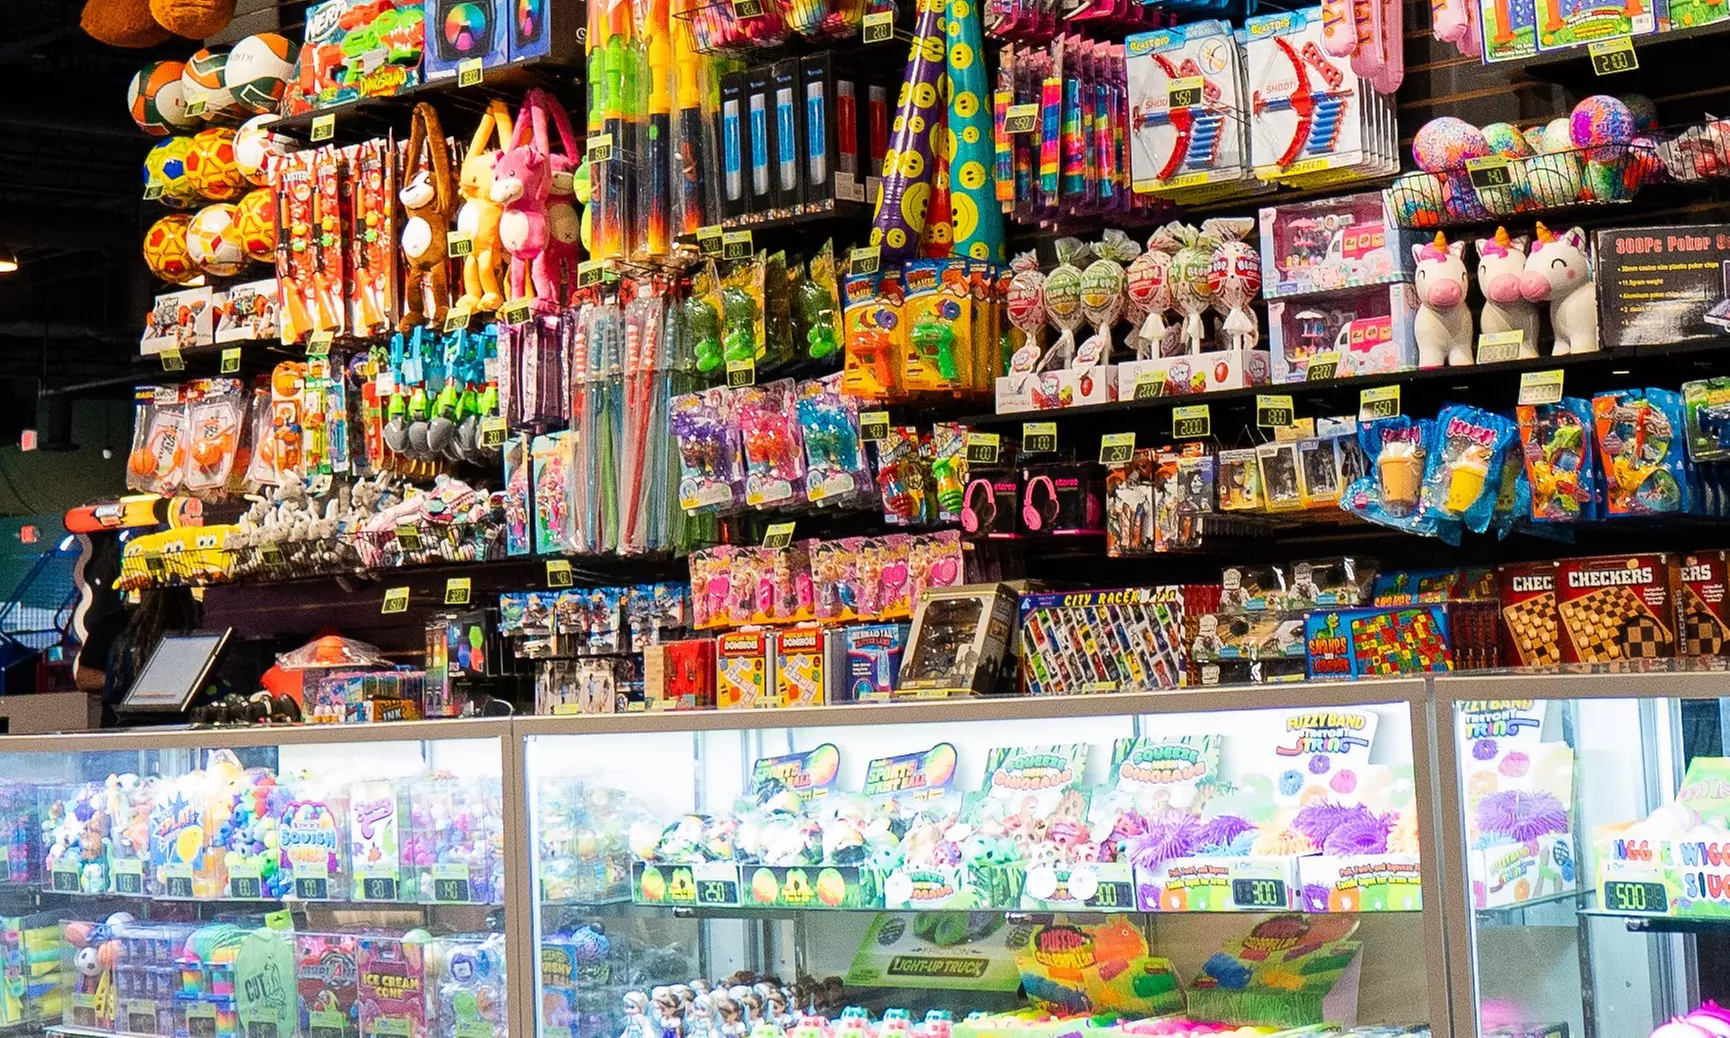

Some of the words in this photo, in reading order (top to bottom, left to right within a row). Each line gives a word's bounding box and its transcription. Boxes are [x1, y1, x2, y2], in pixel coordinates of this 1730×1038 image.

[305, 2, 347, 42] NERF
[1175, 90, 1191, 105] 450
[1615, 237, 1663, 255] 300Pc
[1667, 235, 1711, 252] Poker
[1568, 566, 1653, 588] CHECKERS
[1681, 564, 1712, 582] ERS
[1512, 576, 1555, 592] CHEC
[1063, 593, 1092, 607] CITY
[1098, 590, 1141, 605] RACER
[1287, 713, 1328, 732] FUZZY
[1328, 712, 1366, 731] BAND
[704, 880, 724, 902] 250
[1252, 881, 1276, 904] 300
[1616, 884, 1646, 909] 500
[894, 957, 942, 973] LIGHT-UP
[943, 959, 984, 977] TRUCK
[363, 972, 381, 985] ICE
[381, 974, 420, 990] CREAM
[375, 986, 405, 998] CONE
